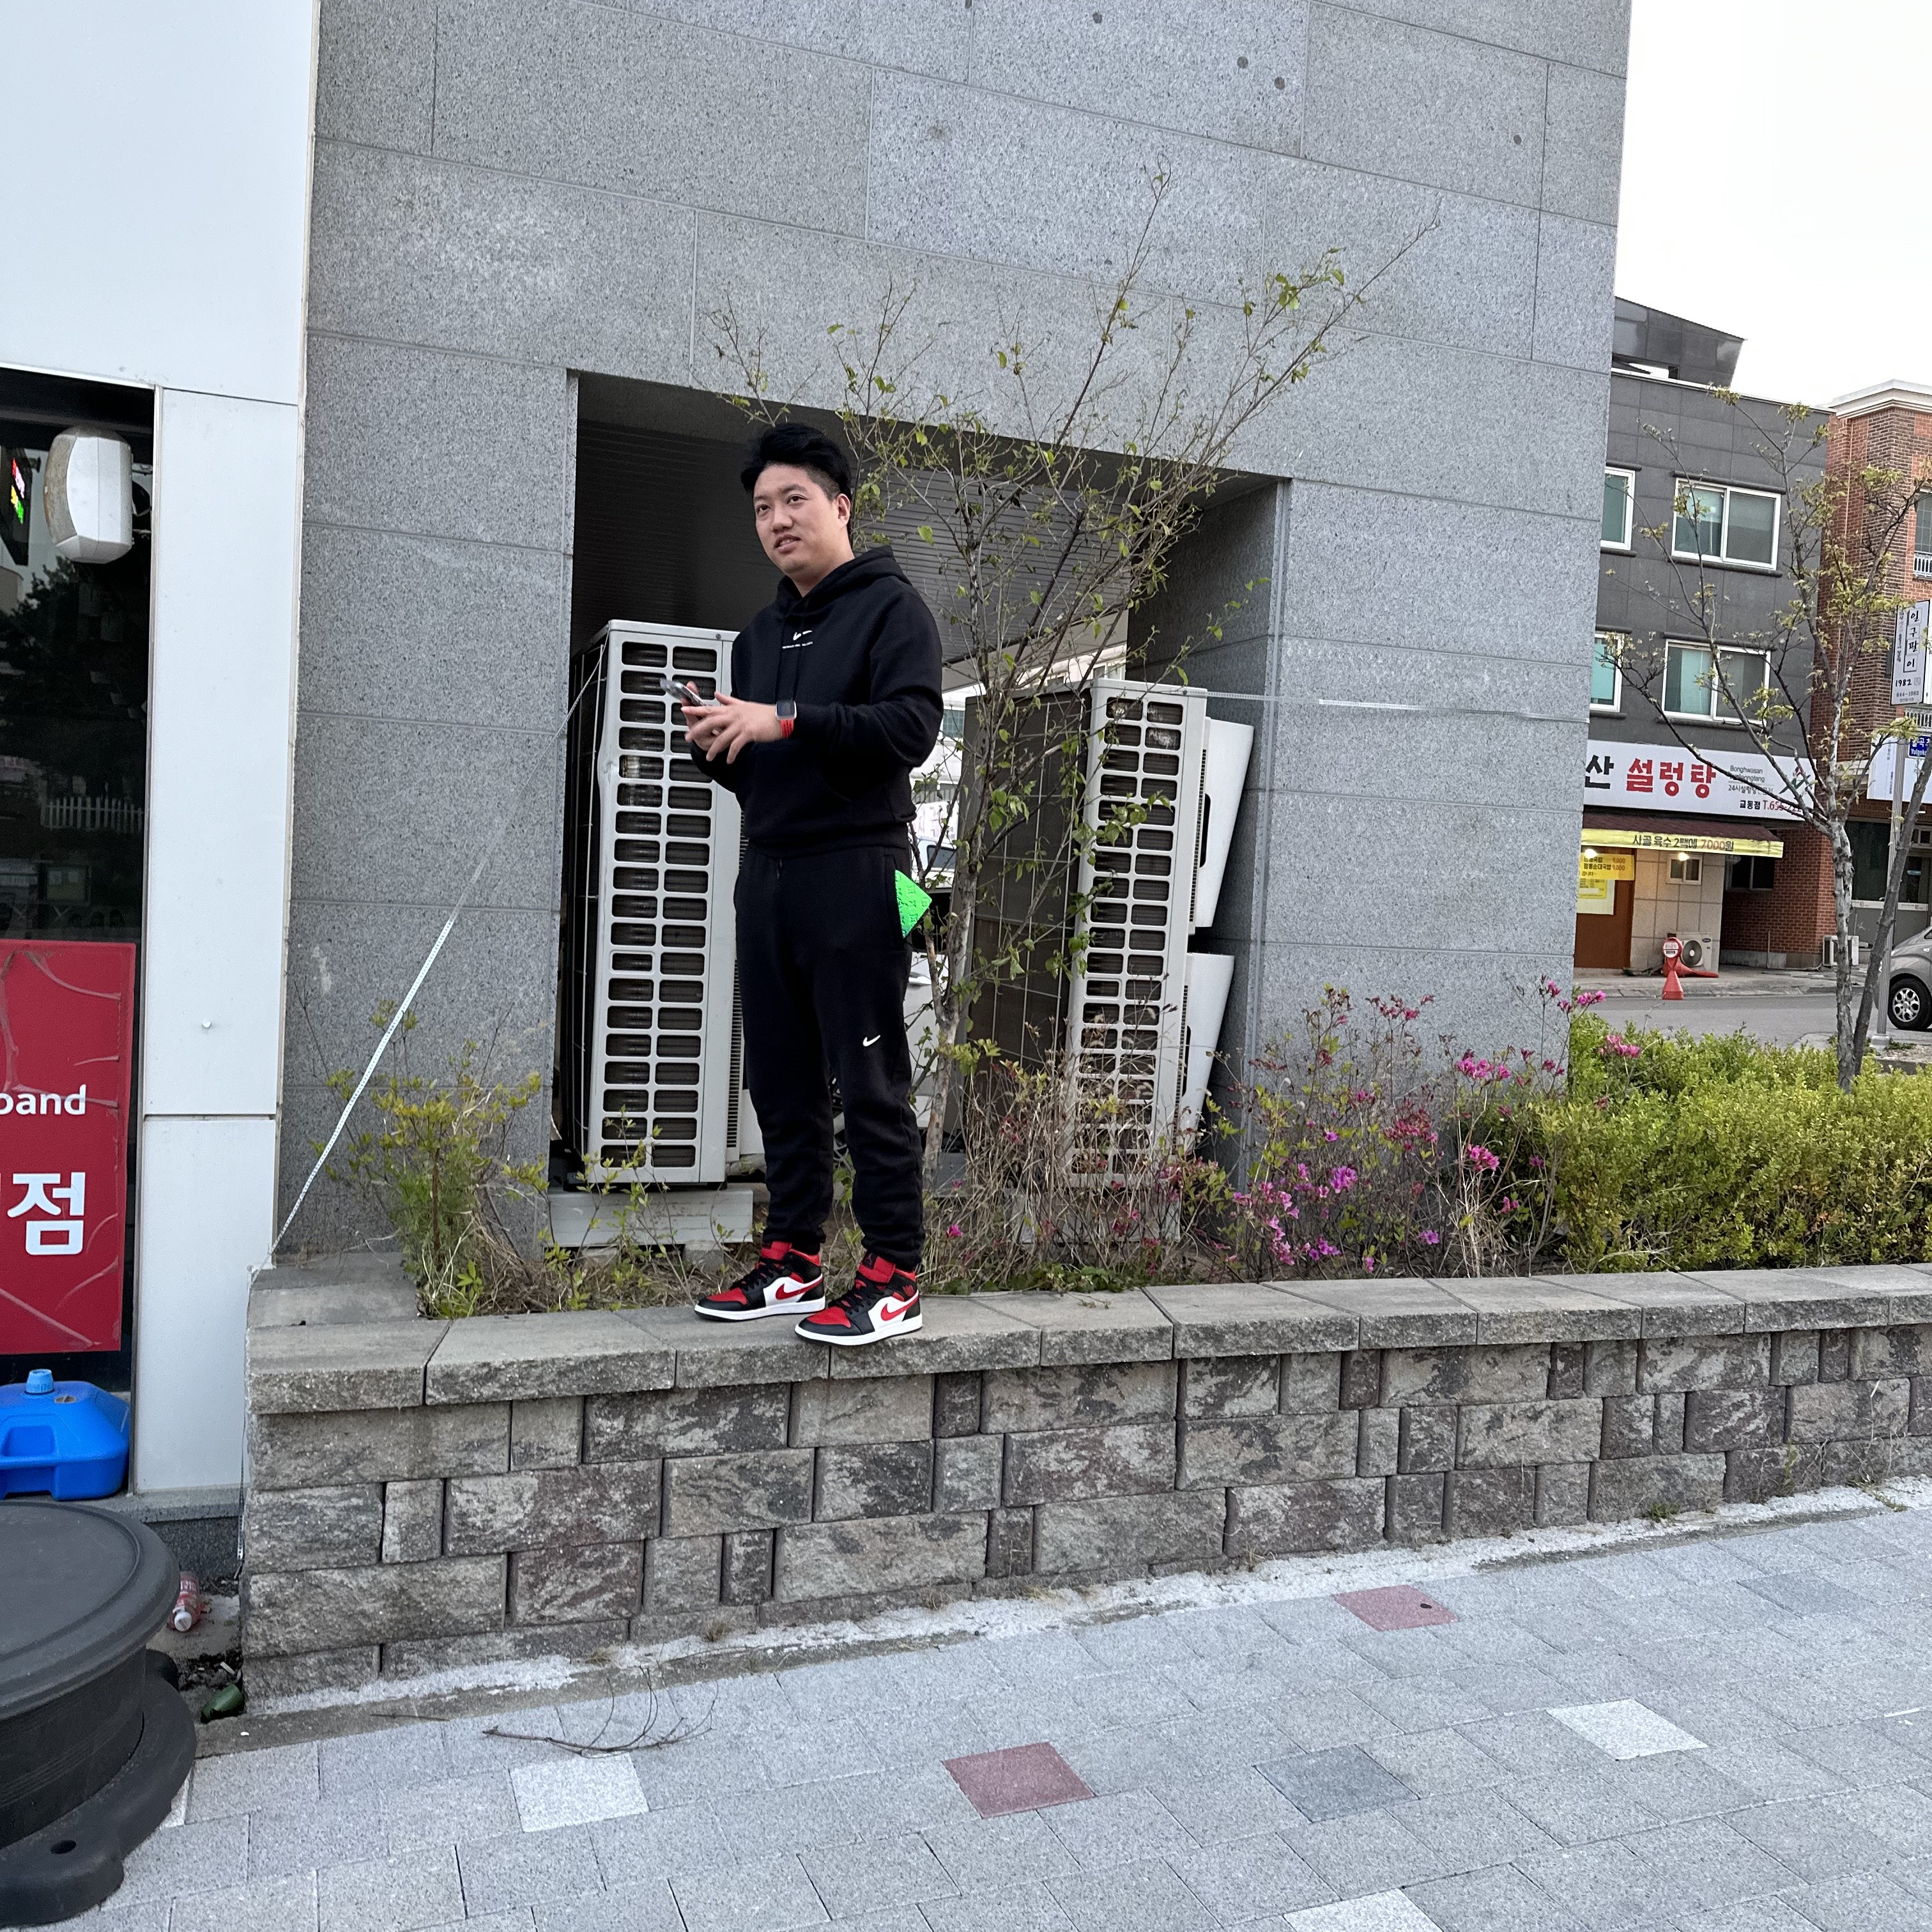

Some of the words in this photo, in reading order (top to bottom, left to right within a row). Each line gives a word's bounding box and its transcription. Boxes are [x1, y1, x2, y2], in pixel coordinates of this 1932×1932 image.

[1906, 610, 1919, 668] 일구팔이
[1895, 678, 1912, 687] 1982
[1626, 758, 1717, 799] 설렁탕
[1739, 800, 1761, 810] 교동점
[7, 1171, 86, 1256] 점
